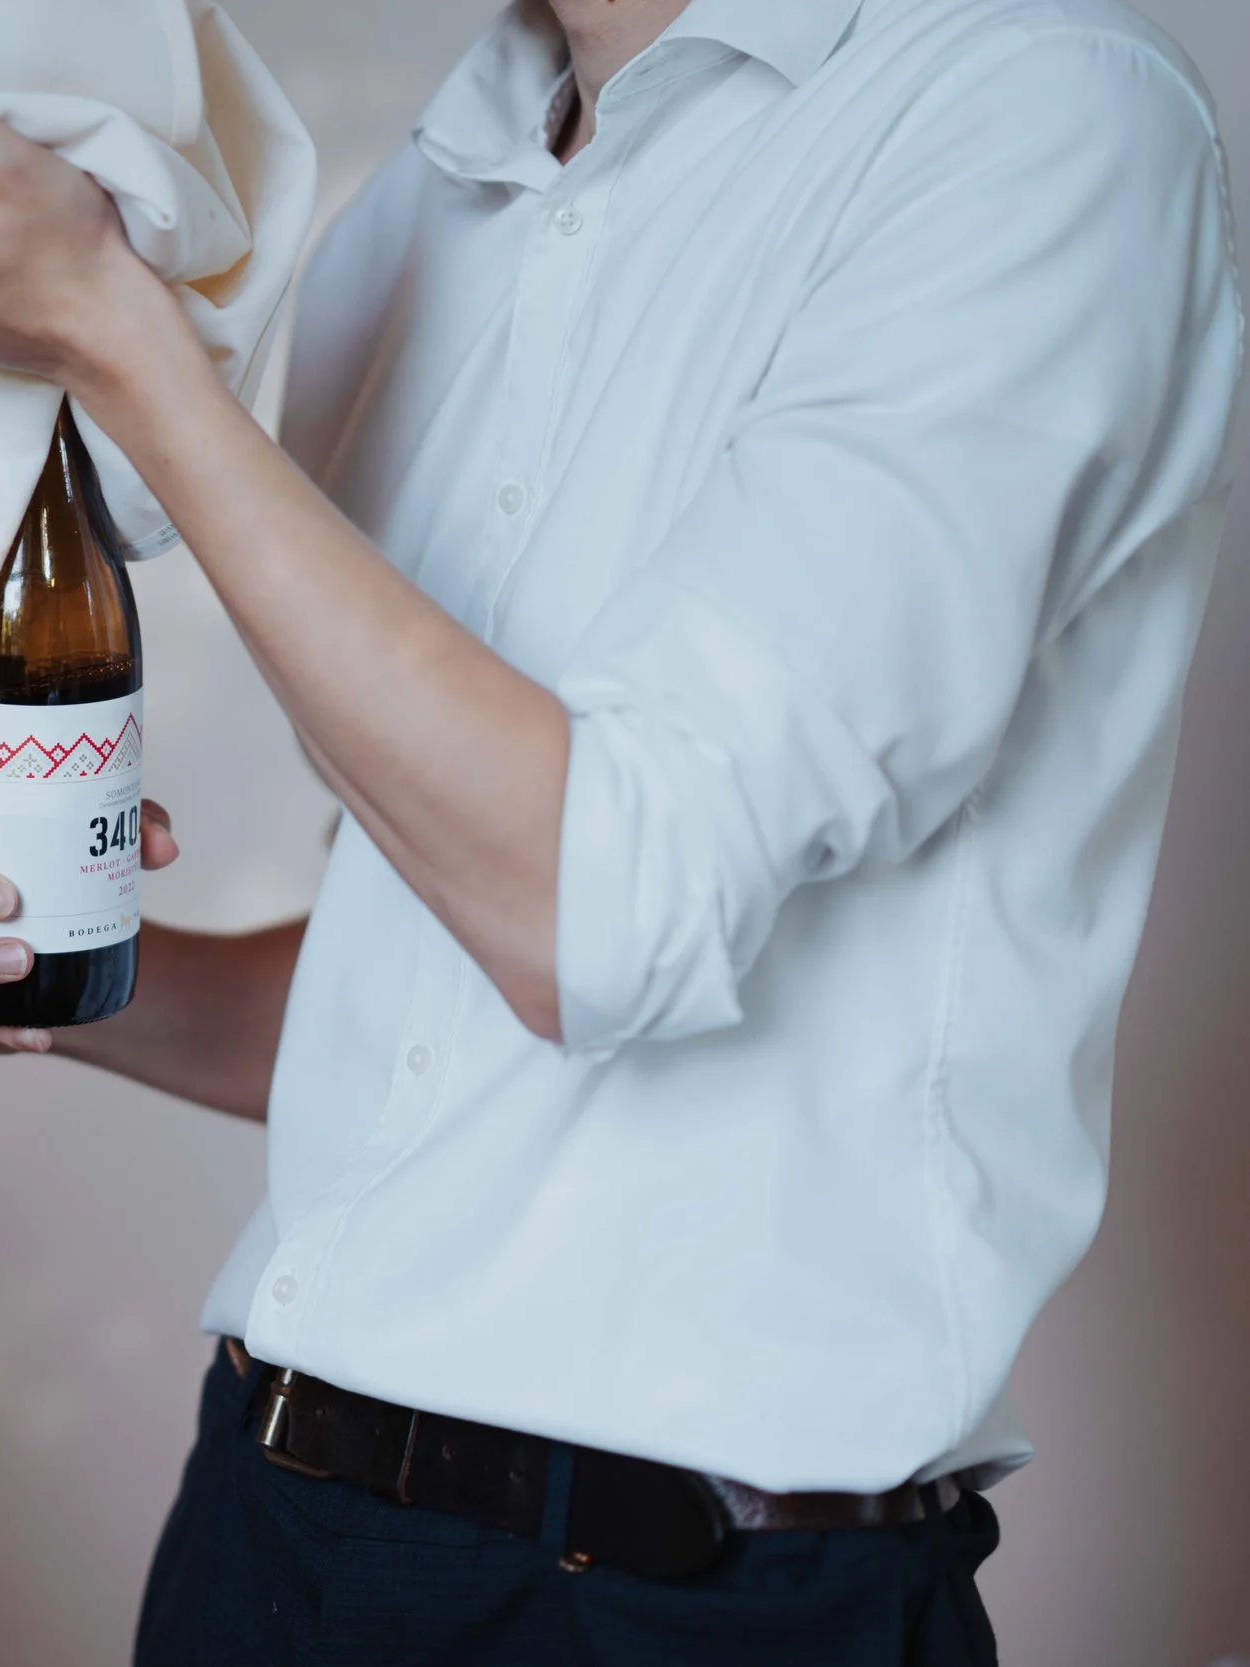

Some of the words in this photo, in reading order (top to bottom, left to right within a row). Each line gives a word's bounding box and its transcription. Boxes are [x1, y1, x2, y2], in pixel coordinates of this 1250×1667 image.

[89, 804, 141, 857] 340
[79, 858, 121, 874] MERLOT
[69, 922, 117, 937] BODEGA
